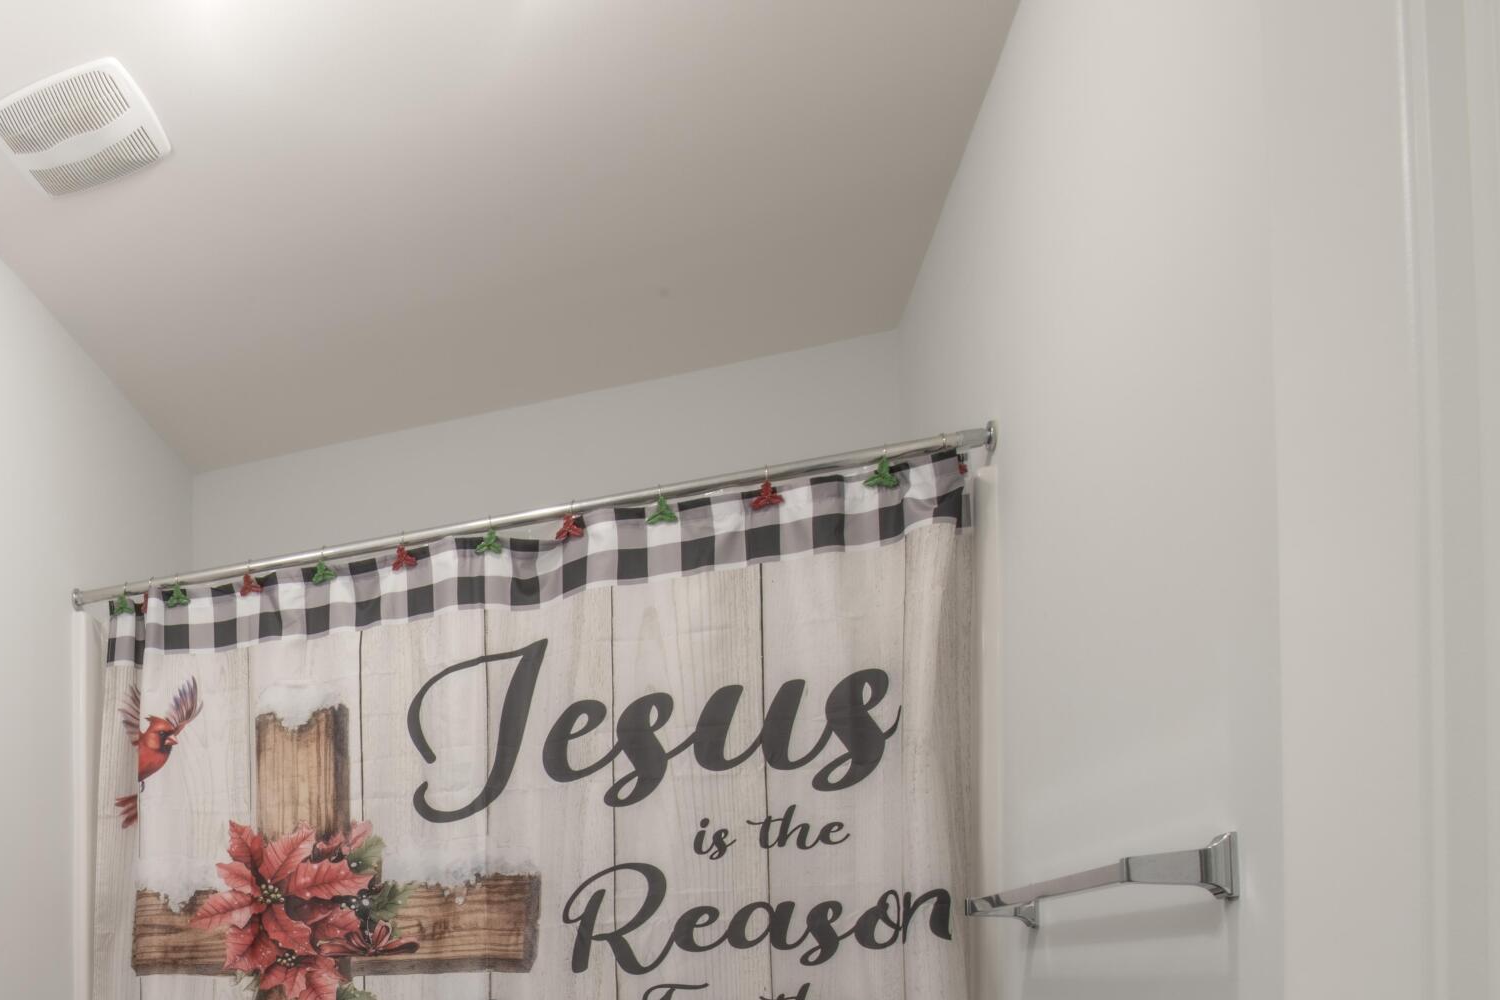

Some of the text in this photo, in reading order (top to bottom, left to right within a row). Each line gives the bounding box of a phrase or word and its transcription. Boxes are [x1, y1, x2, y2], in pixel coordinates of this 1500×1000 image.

[407, 638, 902, 823] Jesus
[693, 804, 851, 860] is the
[562, 861, 953, 976] Reason
